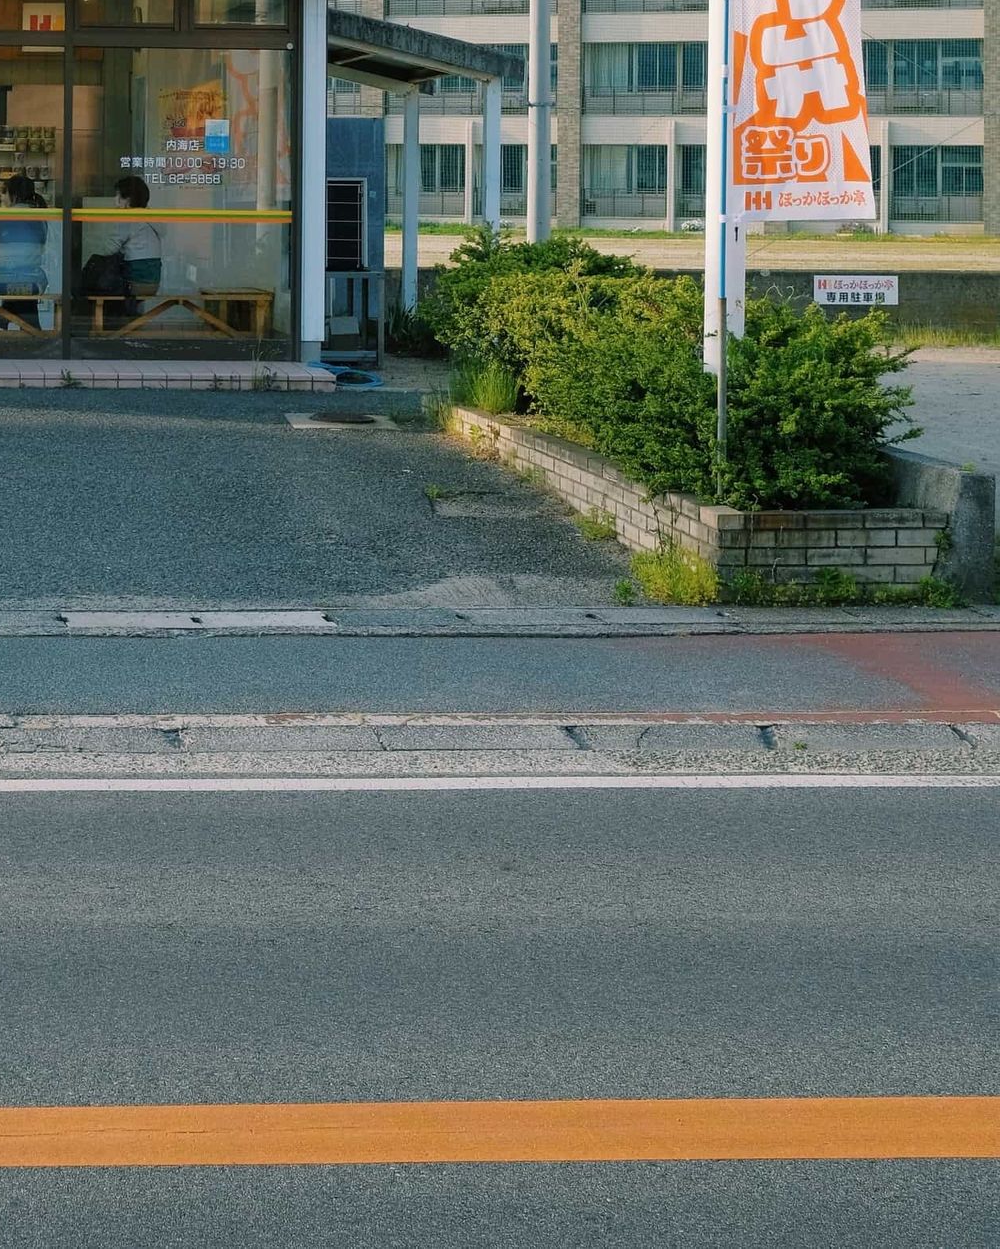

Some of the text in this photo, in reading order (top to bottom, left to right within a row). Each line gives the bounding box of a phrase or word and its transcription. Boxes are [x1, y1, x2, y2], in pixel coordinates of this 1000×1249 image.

[166, 140, 200, 151] 内海店
[743, 126, 829, 178] 祭り
[145, 173, 166, 184] TEL
[778, 190, 866, 207] ほっかほっか亭
[834, 279, 894, 290] ほっかほっか亭
[827, 292, 886, 303] 専用駐車場
